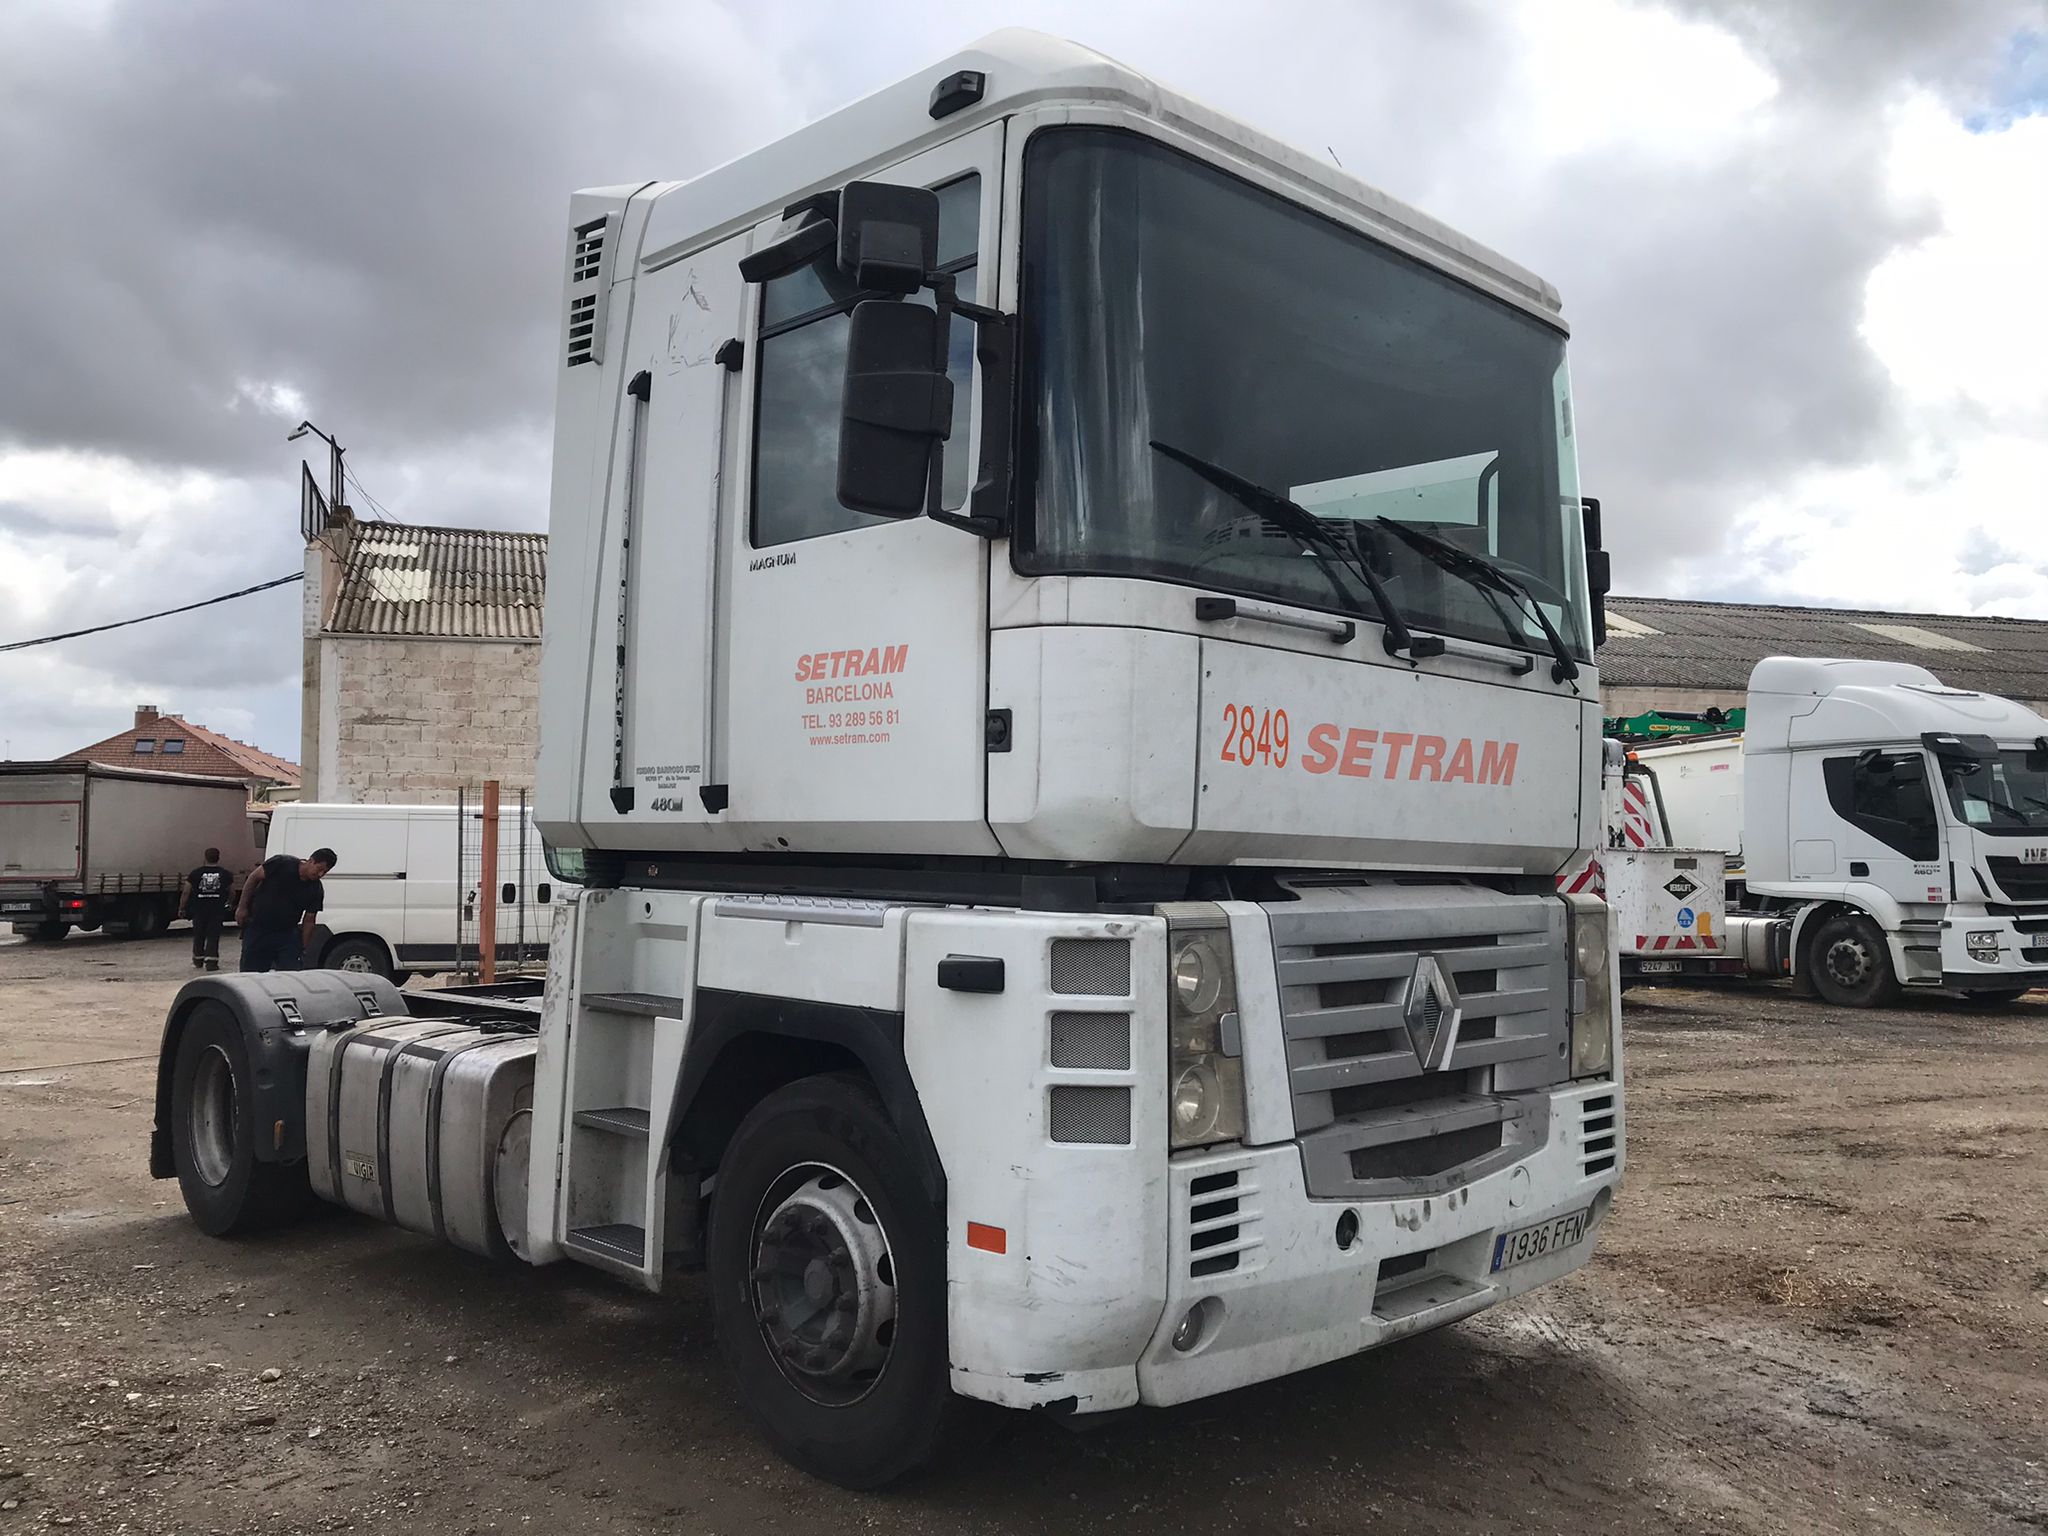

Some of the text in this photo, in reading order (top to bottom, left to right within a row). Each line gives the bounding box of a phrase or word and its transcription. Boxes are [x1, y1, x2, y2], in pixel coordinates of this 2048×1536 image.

[750, 552, 797, 571] MAGNUM
[795, 644, 908, 682] SETRAM
[806, 682, 894, 704] BARCELONA
[801, 709, 899, 730] TEL. 93 289 56 81
[809, 732, 890, 746] www.setram.com
[1220, 703, 1519, 786] 2849 SETRAM
[1508, 1213, 1585, 1264] 1936 FFN
